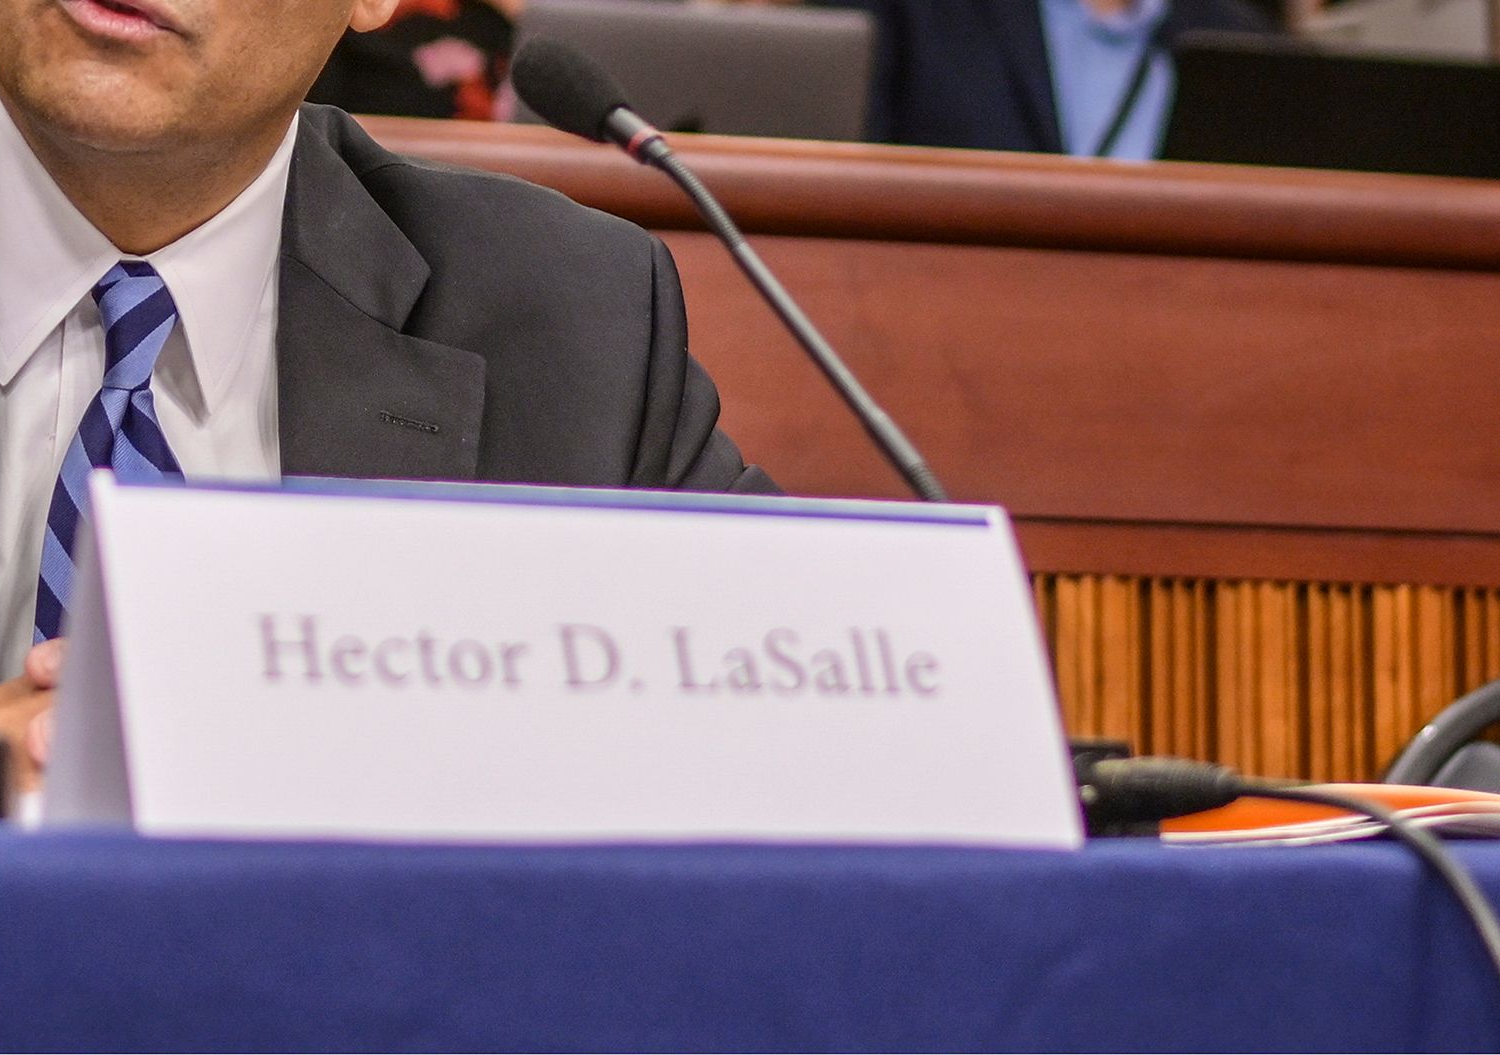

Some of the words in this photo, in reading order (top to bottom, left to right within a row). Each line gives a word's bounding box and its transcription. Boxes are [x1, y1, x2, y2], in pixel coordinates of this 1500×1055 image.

[257, 612, 530, 690] Hector
[556, 623, 645, 690] D.
[671, 626, 941, 697] LaSalle
